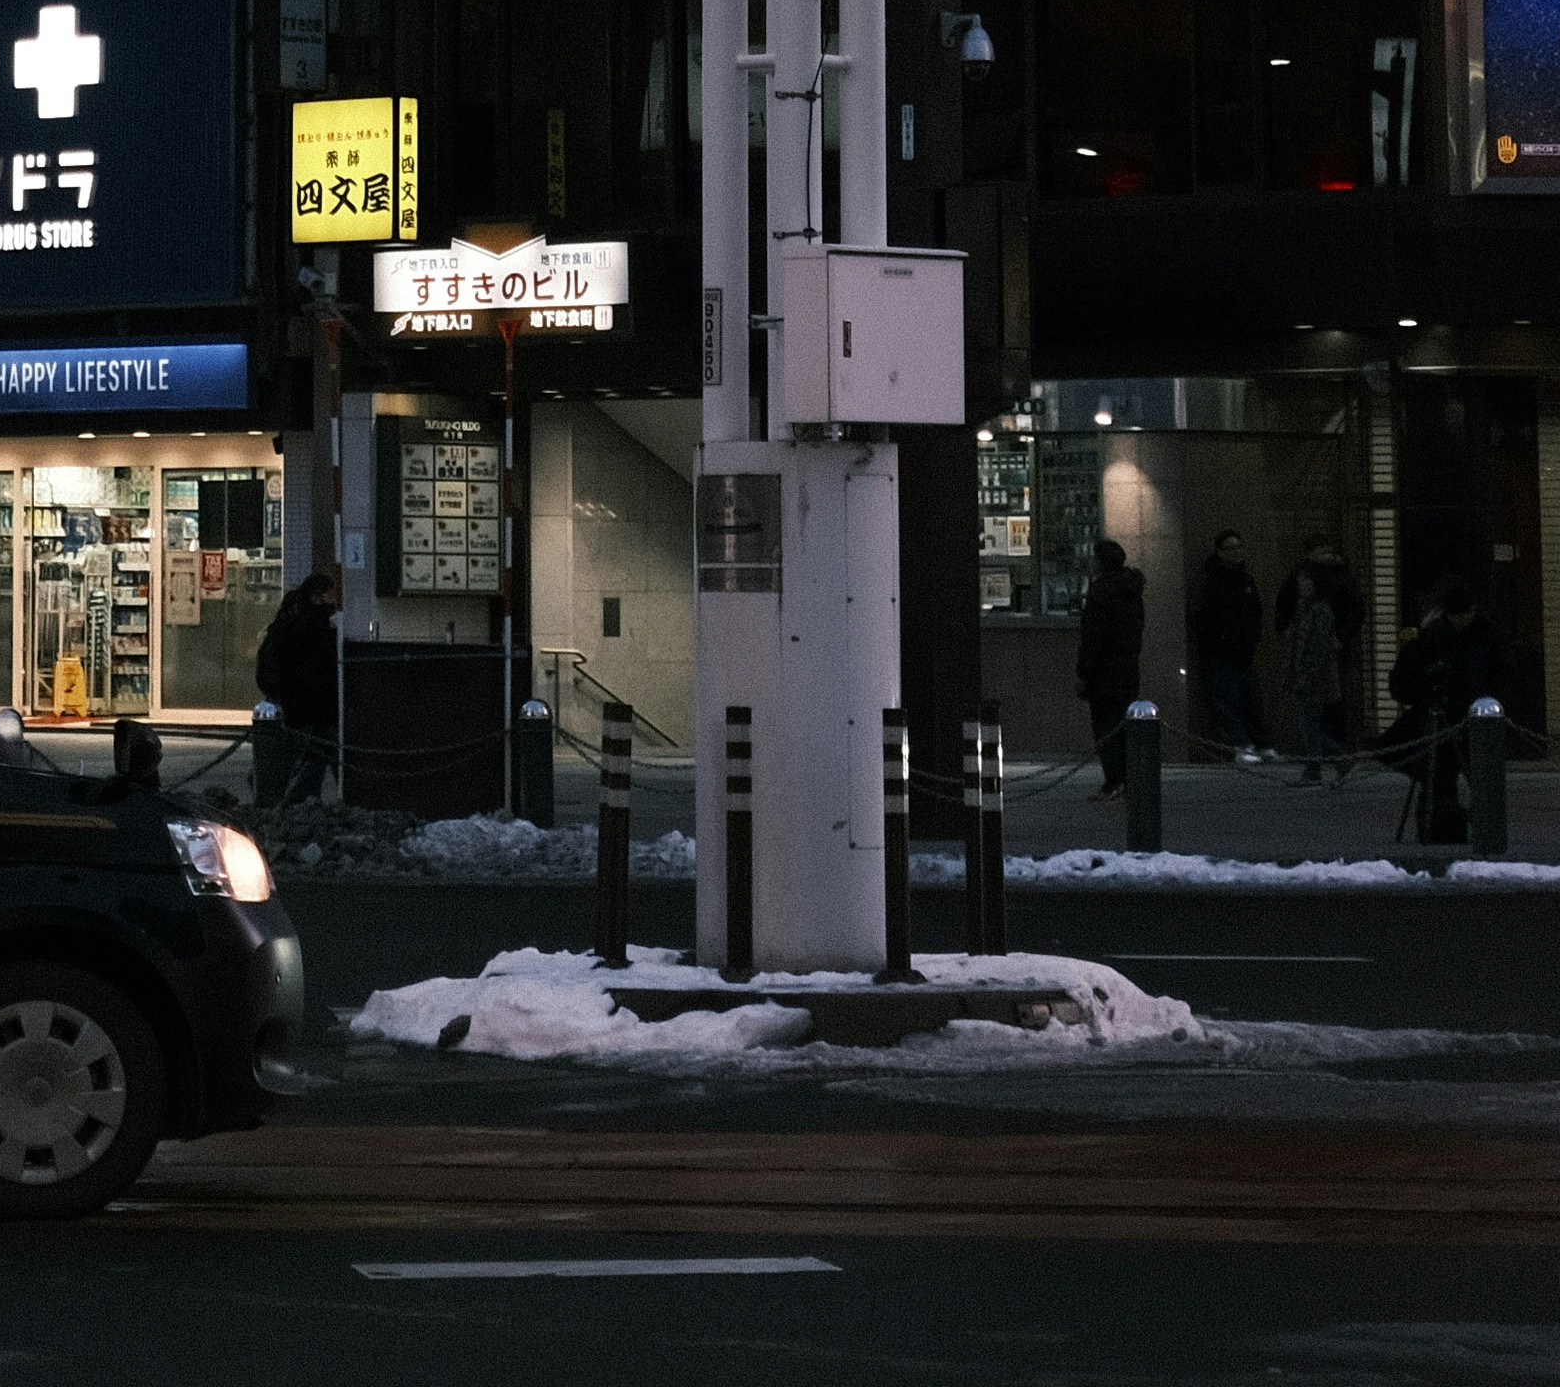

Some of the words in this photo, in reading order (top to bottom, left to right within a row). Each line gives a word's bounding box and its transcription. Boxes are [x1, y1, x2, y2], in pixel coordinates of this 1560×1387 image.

[296, 173, 391, 216] 四文屋
[40, 220, 94, 248] STORE
[540, 252, 593, 266] 地下飲食街
[412, 270, 589, 306] すすきのビル
[64, 358, 171, 393] LIFESTYLE
